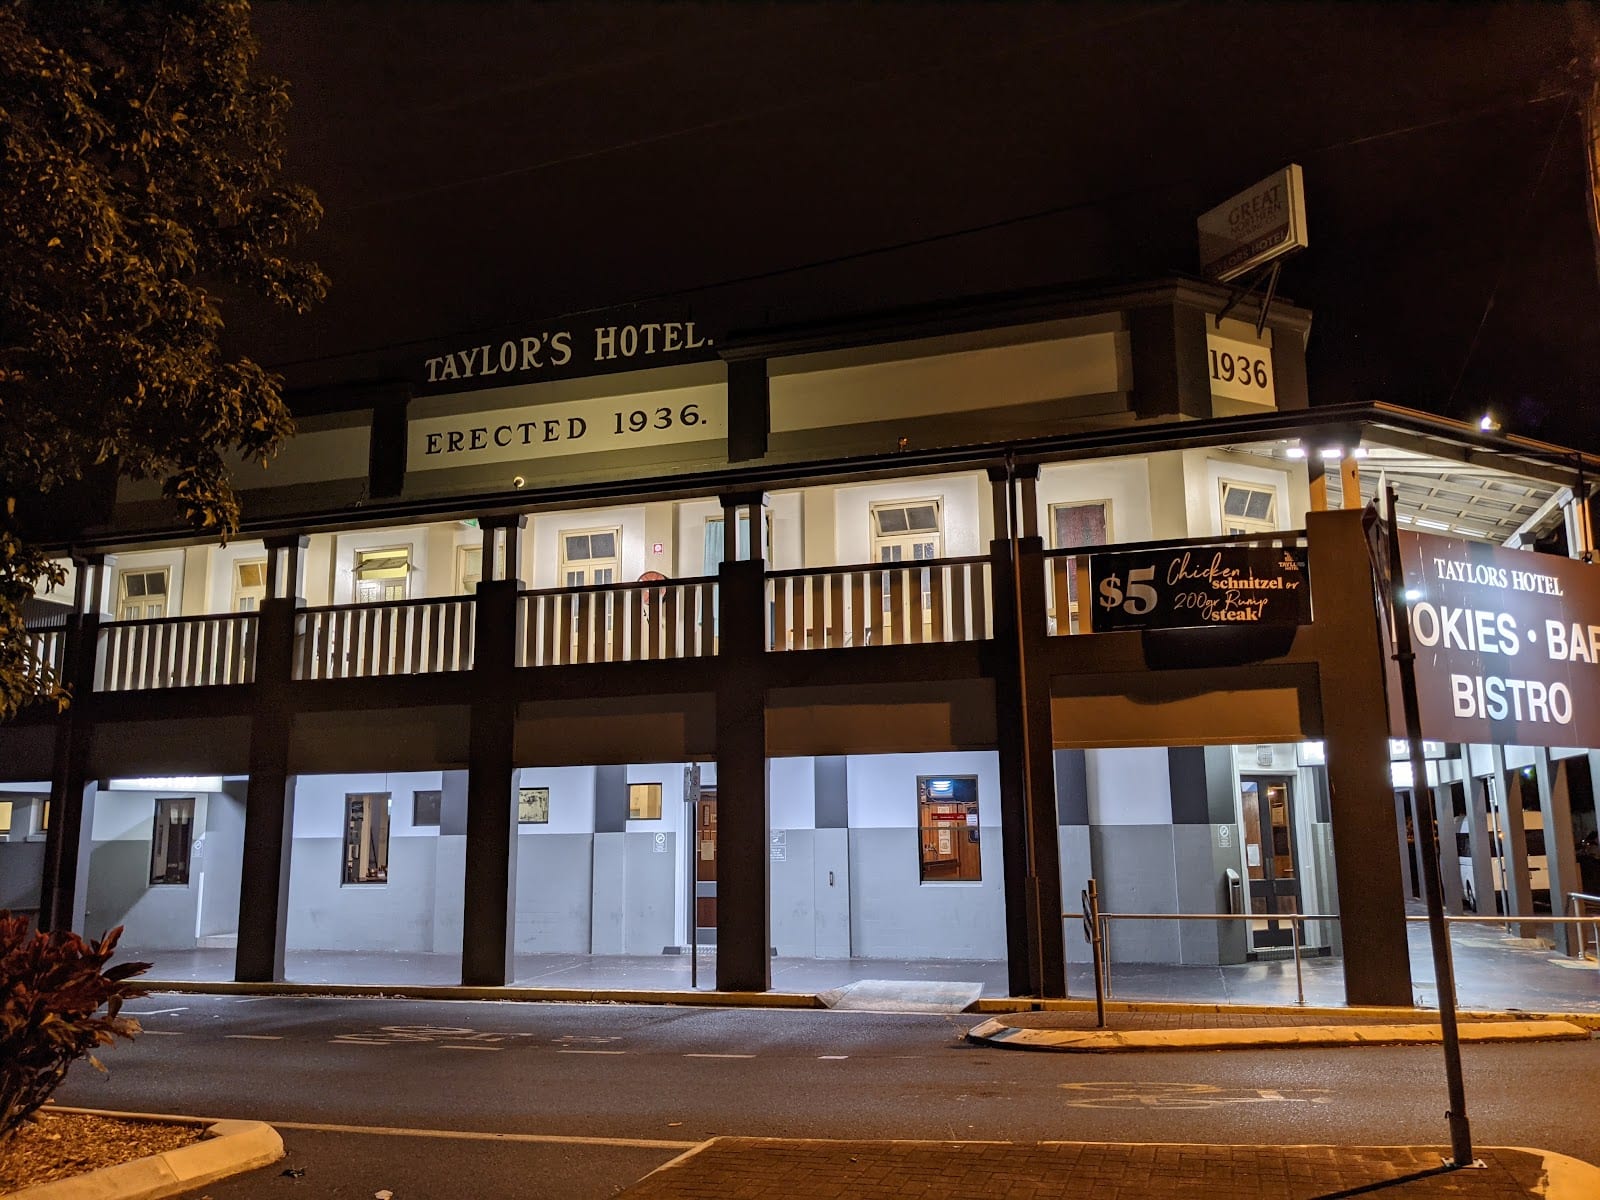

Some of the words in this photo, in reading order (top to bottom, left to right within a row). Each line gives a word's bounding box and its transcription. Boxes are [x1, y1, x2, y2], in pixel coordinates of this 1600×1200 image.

[1228, 184, 1281, 225] GREAT
[425, 332, 571, 382] TAYLOR'S
[594, 322, 714, 361] HOTEL.
[1210, 349, 1267, 389] 1936
[425, 417, 587, 455] ERECTED
[614, 404, 707, 434] 1936.
[1167, 551, 1240, 586] Chicken
[1211, 576, 1283, 590] schnitzel
[1285, 581, 1300, 590] or
[1433, 558, 1508, 589] TAYLORS
[1511, 570, 1564, 597] HOTEL
[1099, 565, 1159, 615] $5
[1174, 591, 1220, 621] 200gr
[1225, 589, 1269, 618] Rump
[1211, 608, 1259, 622] steak
[1451, 673, 1573, 725] BISTRO
